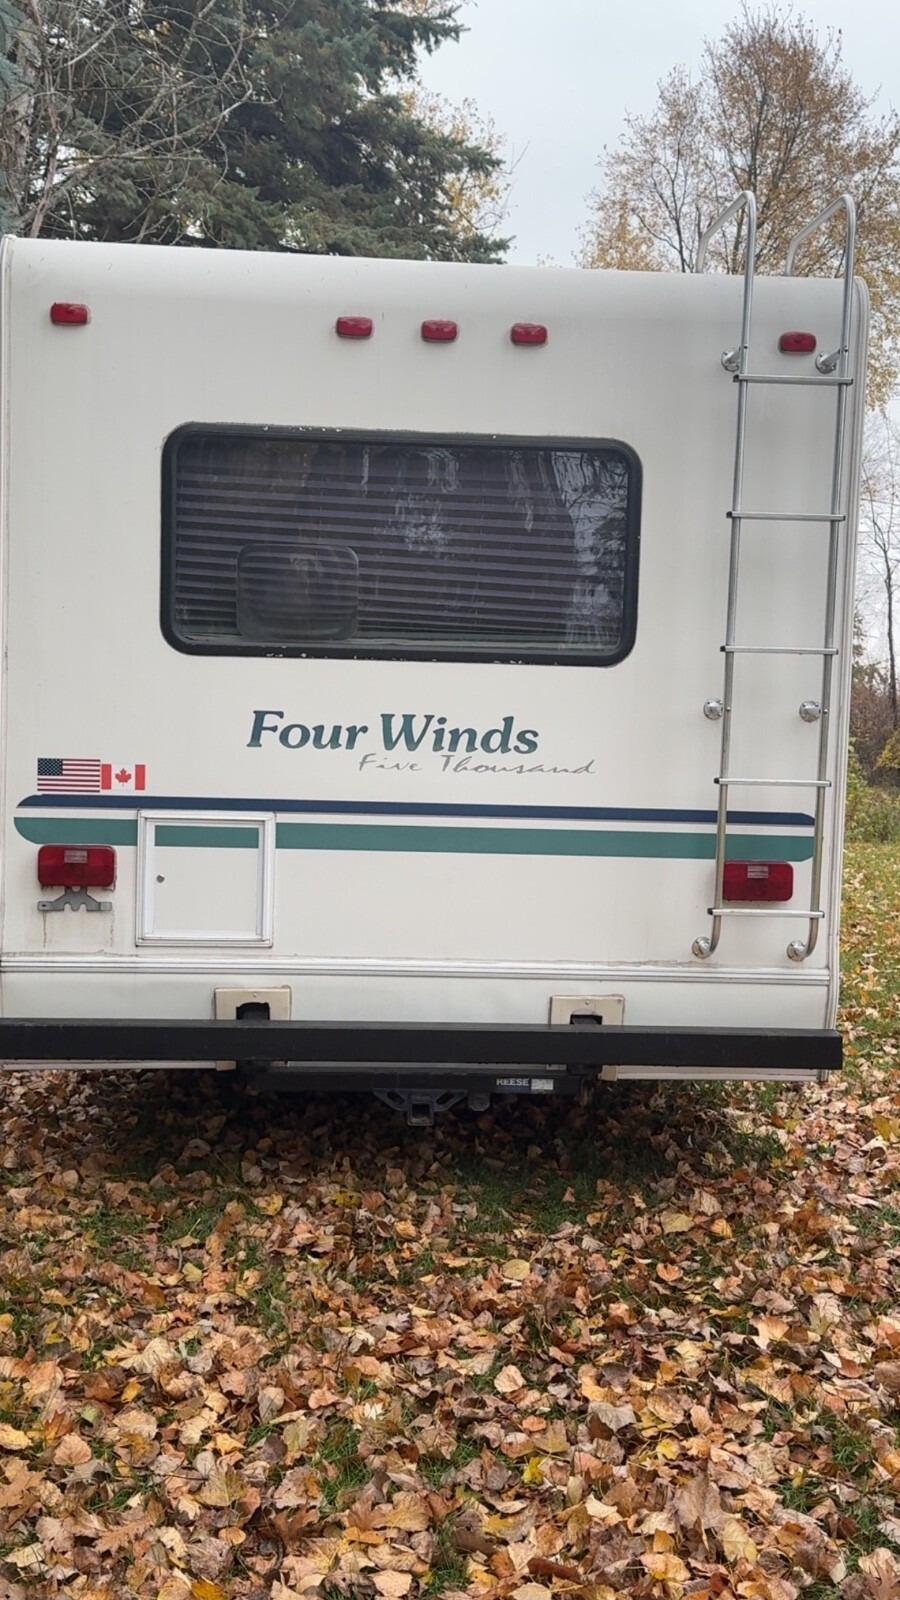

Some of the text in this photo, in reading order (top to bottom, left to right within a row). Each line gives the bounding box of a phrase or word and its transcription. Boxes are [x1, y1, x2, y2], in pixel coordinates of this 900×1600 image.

[246, 710, 540, 755] Four Winds
[358, 753, 596, 775] Five Thousand
[496, 1077, 530, 1087] REESE
